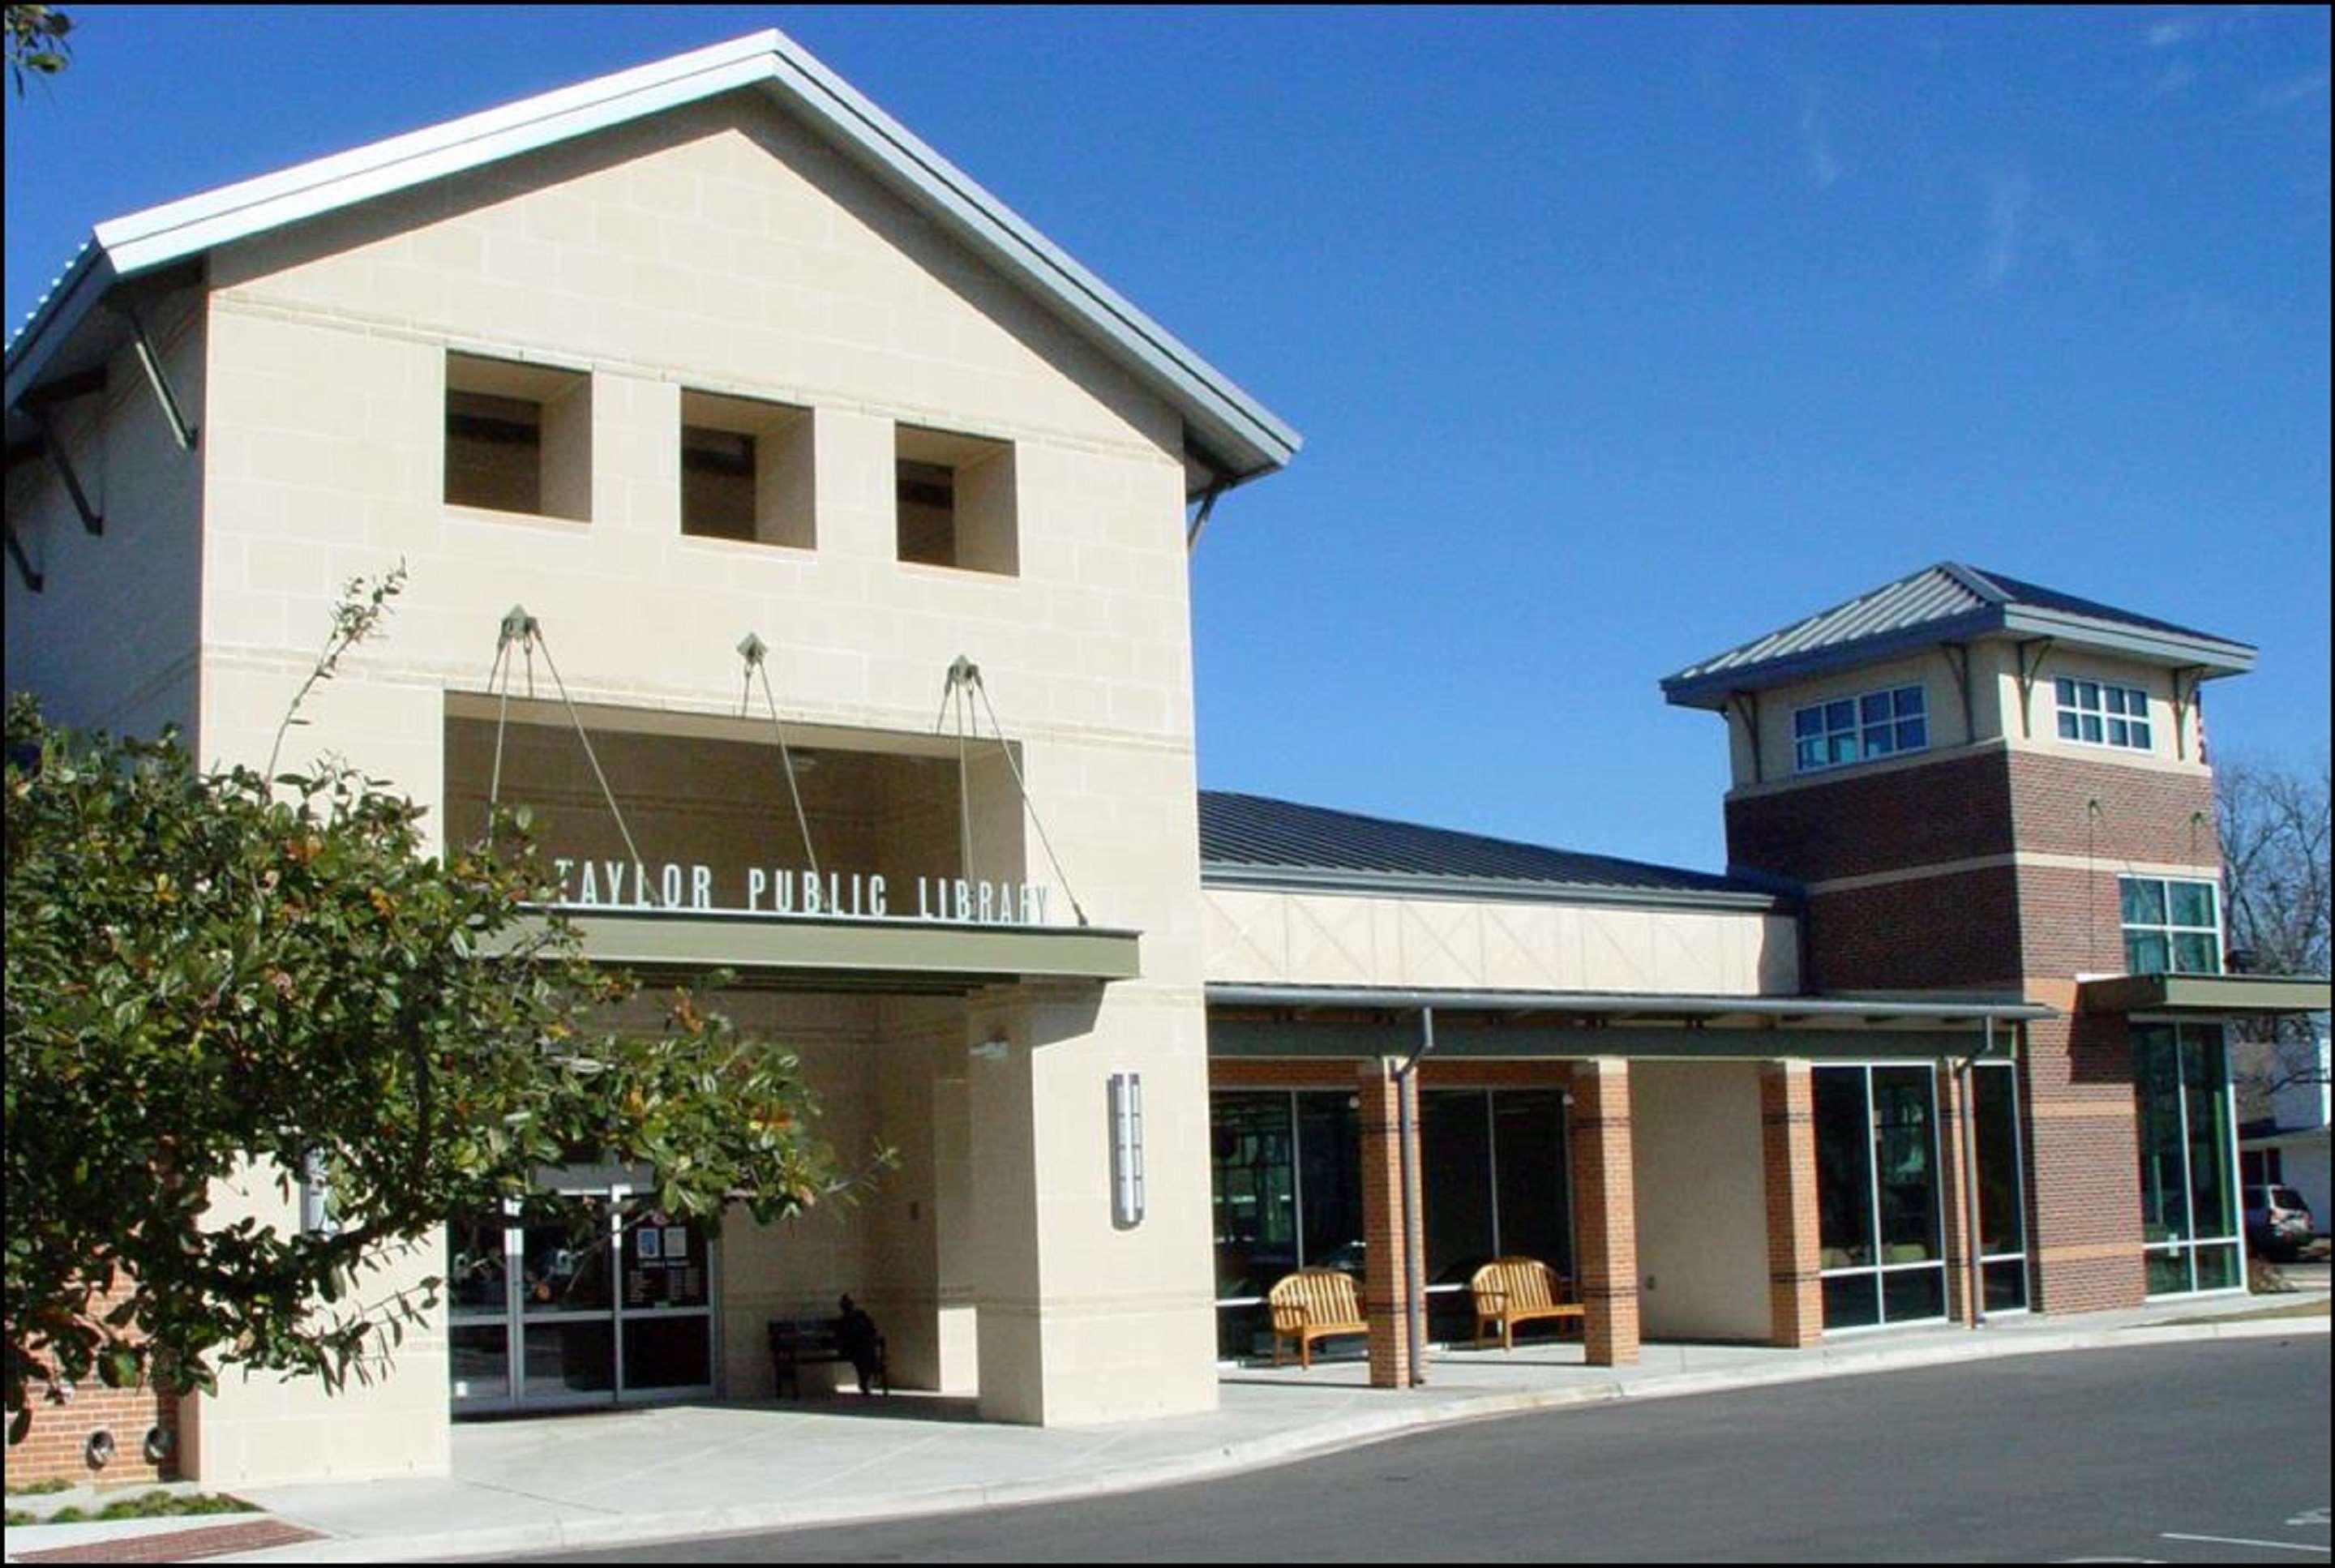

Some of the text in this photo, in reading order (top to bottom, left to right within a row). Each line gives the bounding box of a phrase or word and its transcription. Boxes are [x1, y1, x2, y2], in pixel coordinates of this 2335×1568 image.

[555, 859, 1049, 924] TAYLOR PUBLIC LIBRARY
